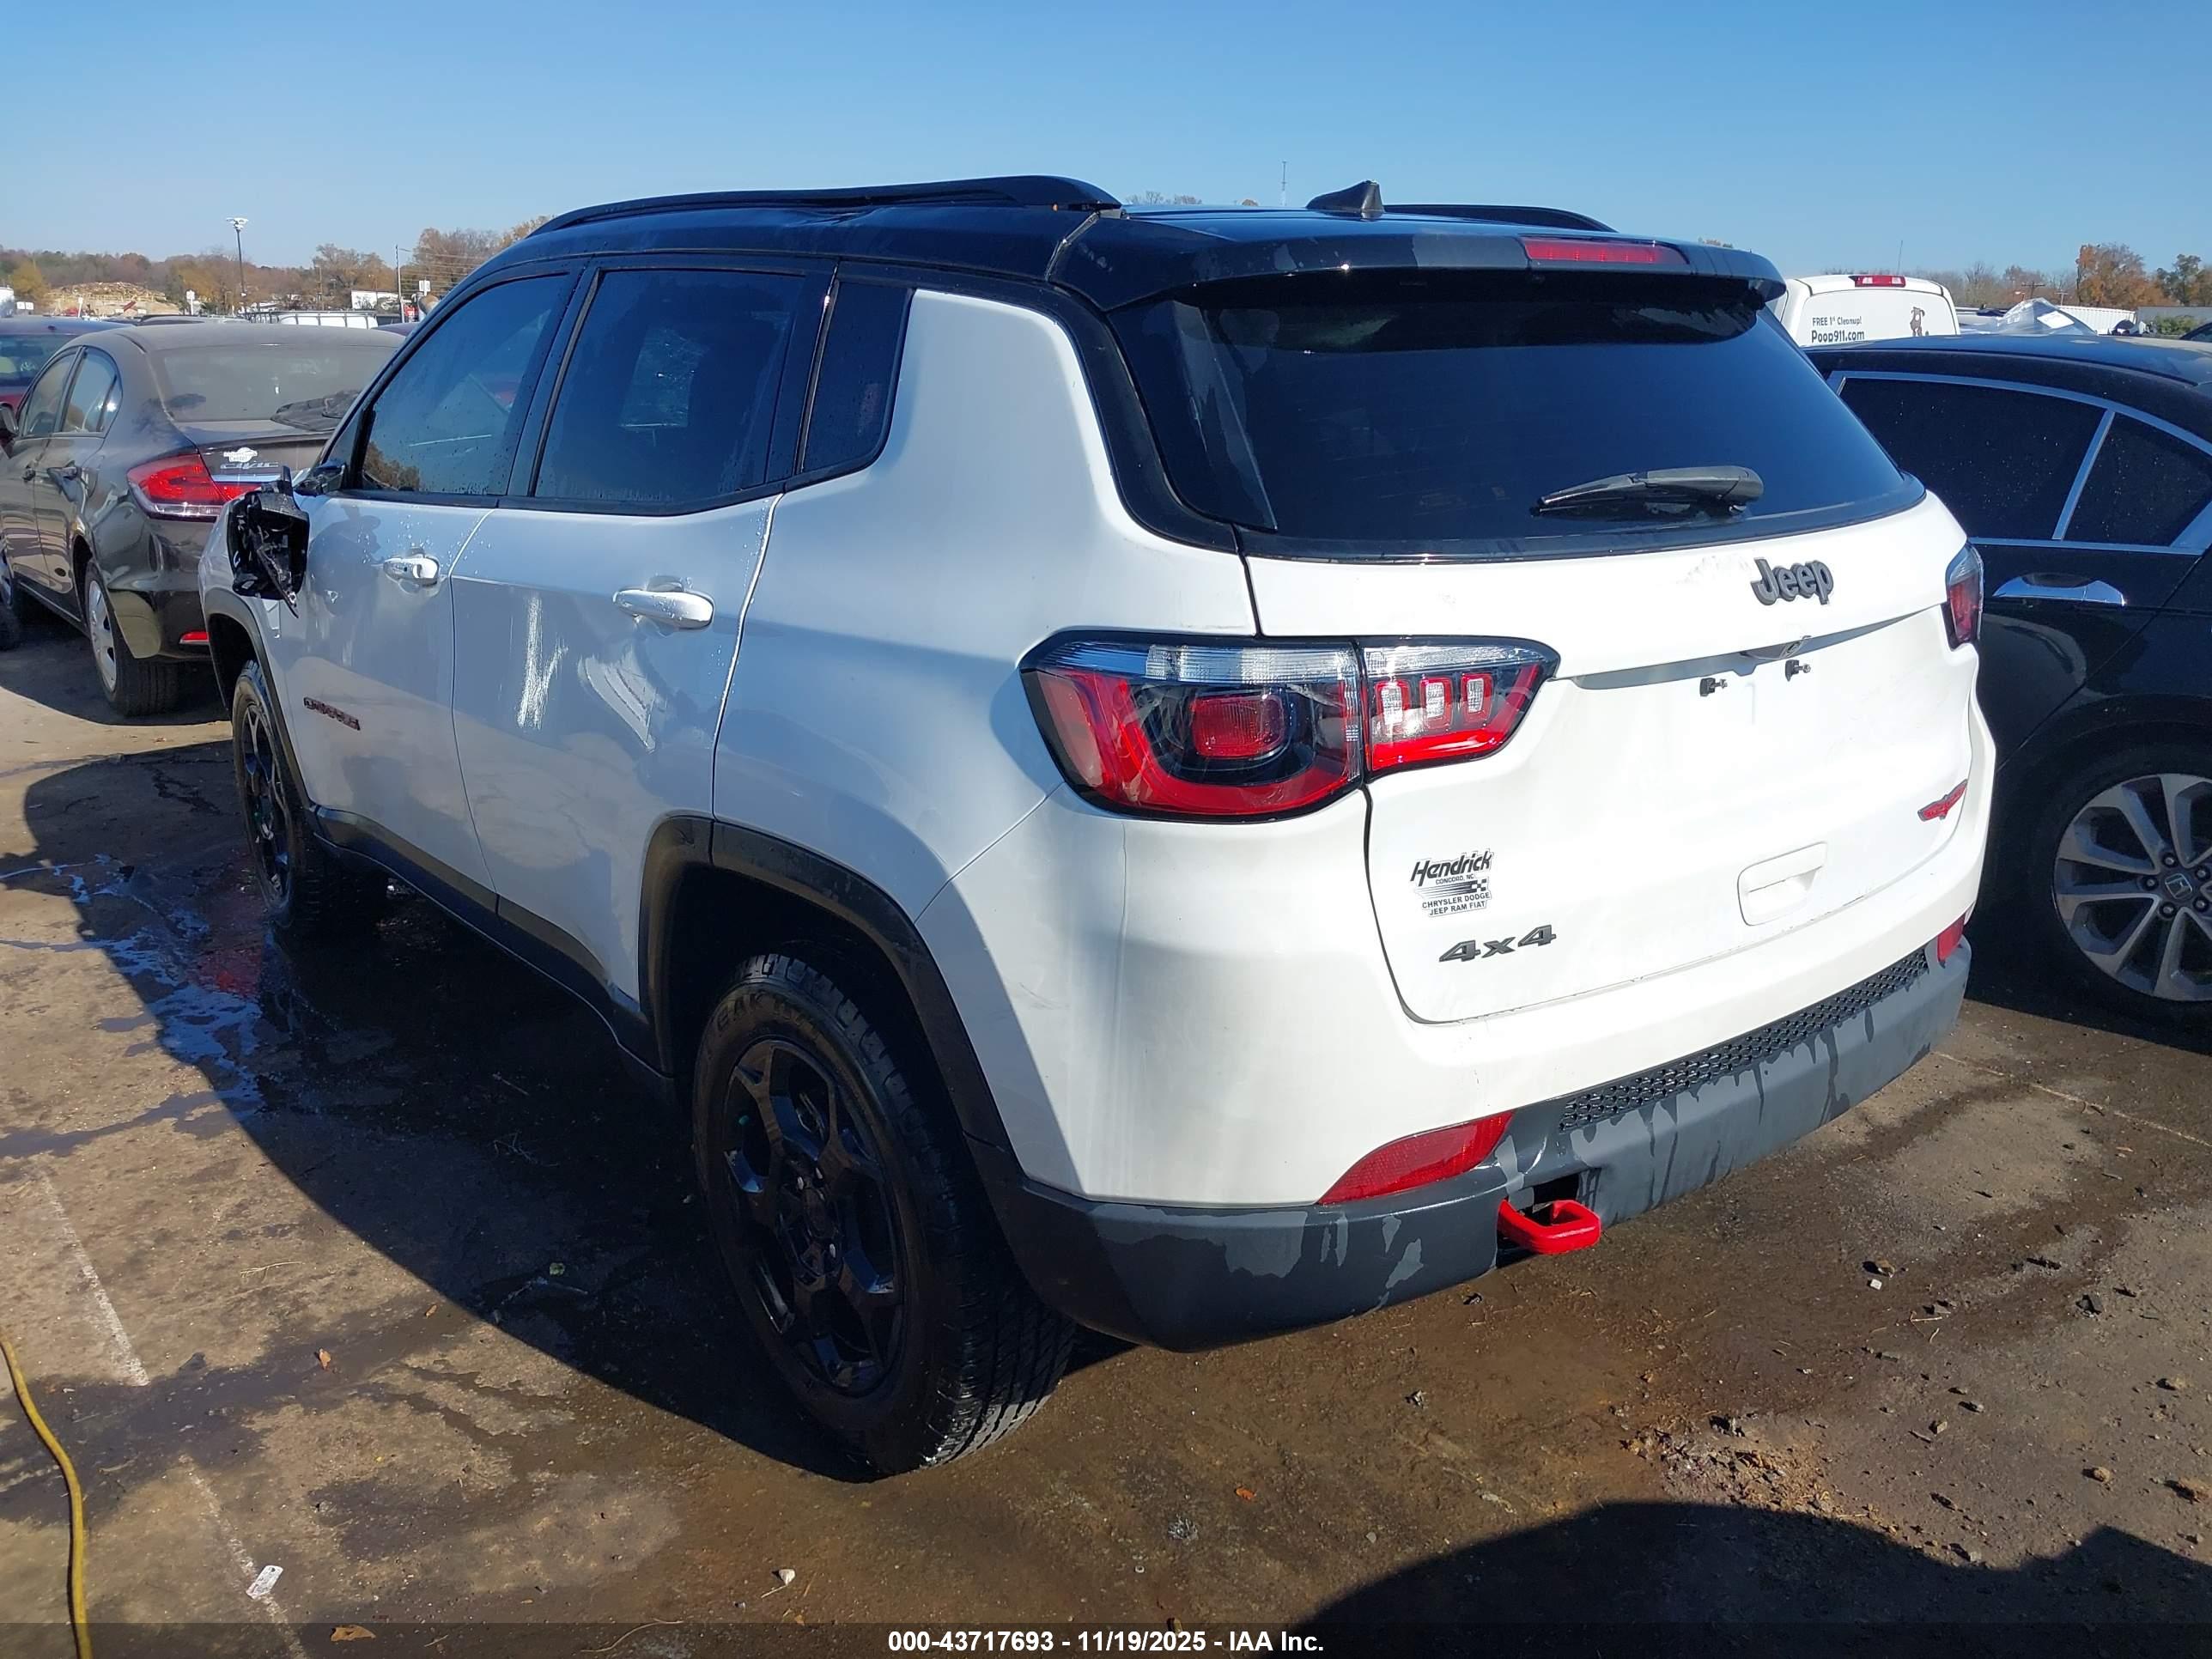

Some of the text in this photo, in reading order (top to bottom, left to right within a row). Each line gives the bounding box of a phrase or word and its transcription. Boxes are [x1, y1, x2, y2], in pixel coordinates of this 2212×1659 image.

[1812, 317, 1828, 326] FREE
[1750, 557, 1834, 606] Jeep
[1410, 851, 1492, 886] Hendrick
[1422, 891, 1491, 908] CHRYSLER DODGE
[1429, 900, 1486, 916] JEEP RAM FIAT
[1439, 924, 1557, 963] 4x4
